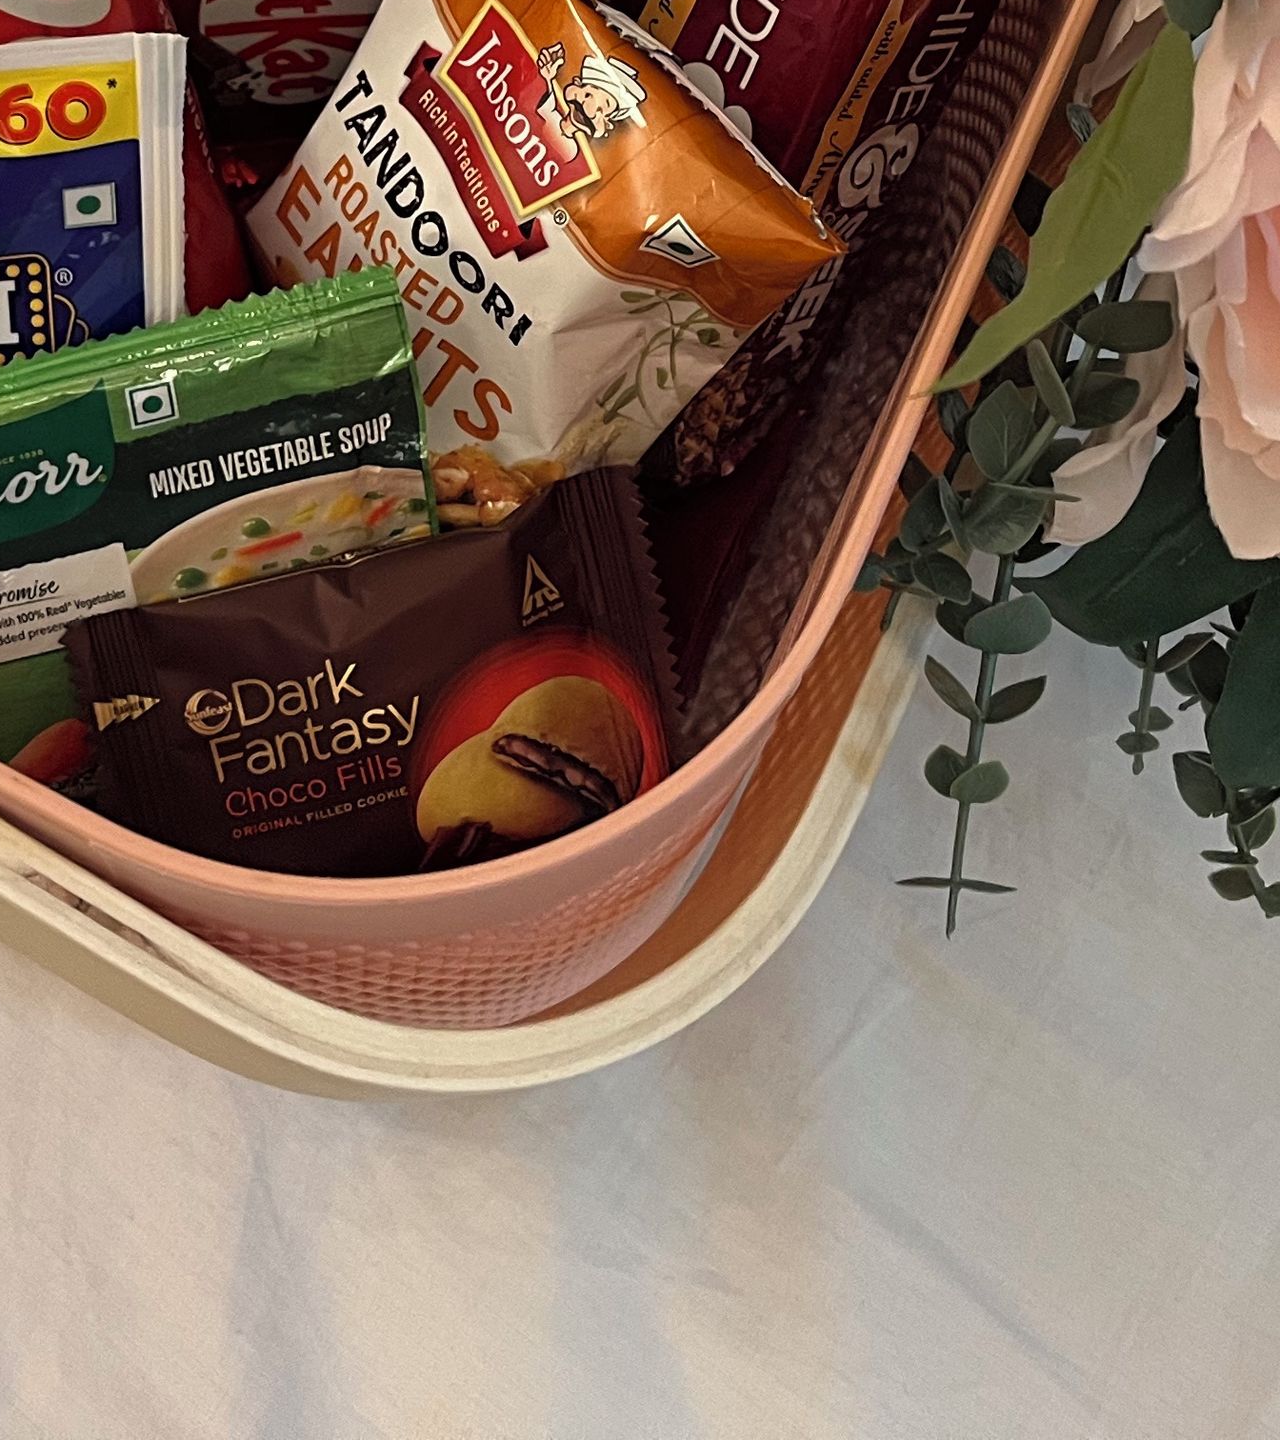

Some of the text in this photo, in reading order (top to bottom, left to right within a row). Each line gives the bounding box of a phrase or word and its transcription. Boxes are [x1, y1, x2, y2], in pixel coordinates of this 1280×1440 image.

[458, 30, 560, 188] Jabsons
[418, 88, 501, 234] Rich in Traditions
[837, 122, 919, 209] &
[324, 154, 465, 326] ROASTED
[335, 68, 533, 347] TANDOORI
[148, 413, 392, 498] MIXED VEGETABLE SOUP
[16, 611, 45, 625] 100%
[74, 589, 126, 611] Vegetables
[184, 701, 232, 723] Sunfeast
[232, 659, 363, 726] Dark
[209, 695, 419, 783] Fantasy
[226, 754, 402, 817] Choco Fills
[232, 785, 409, 839] ORIGINAL FILLED COOKIE
